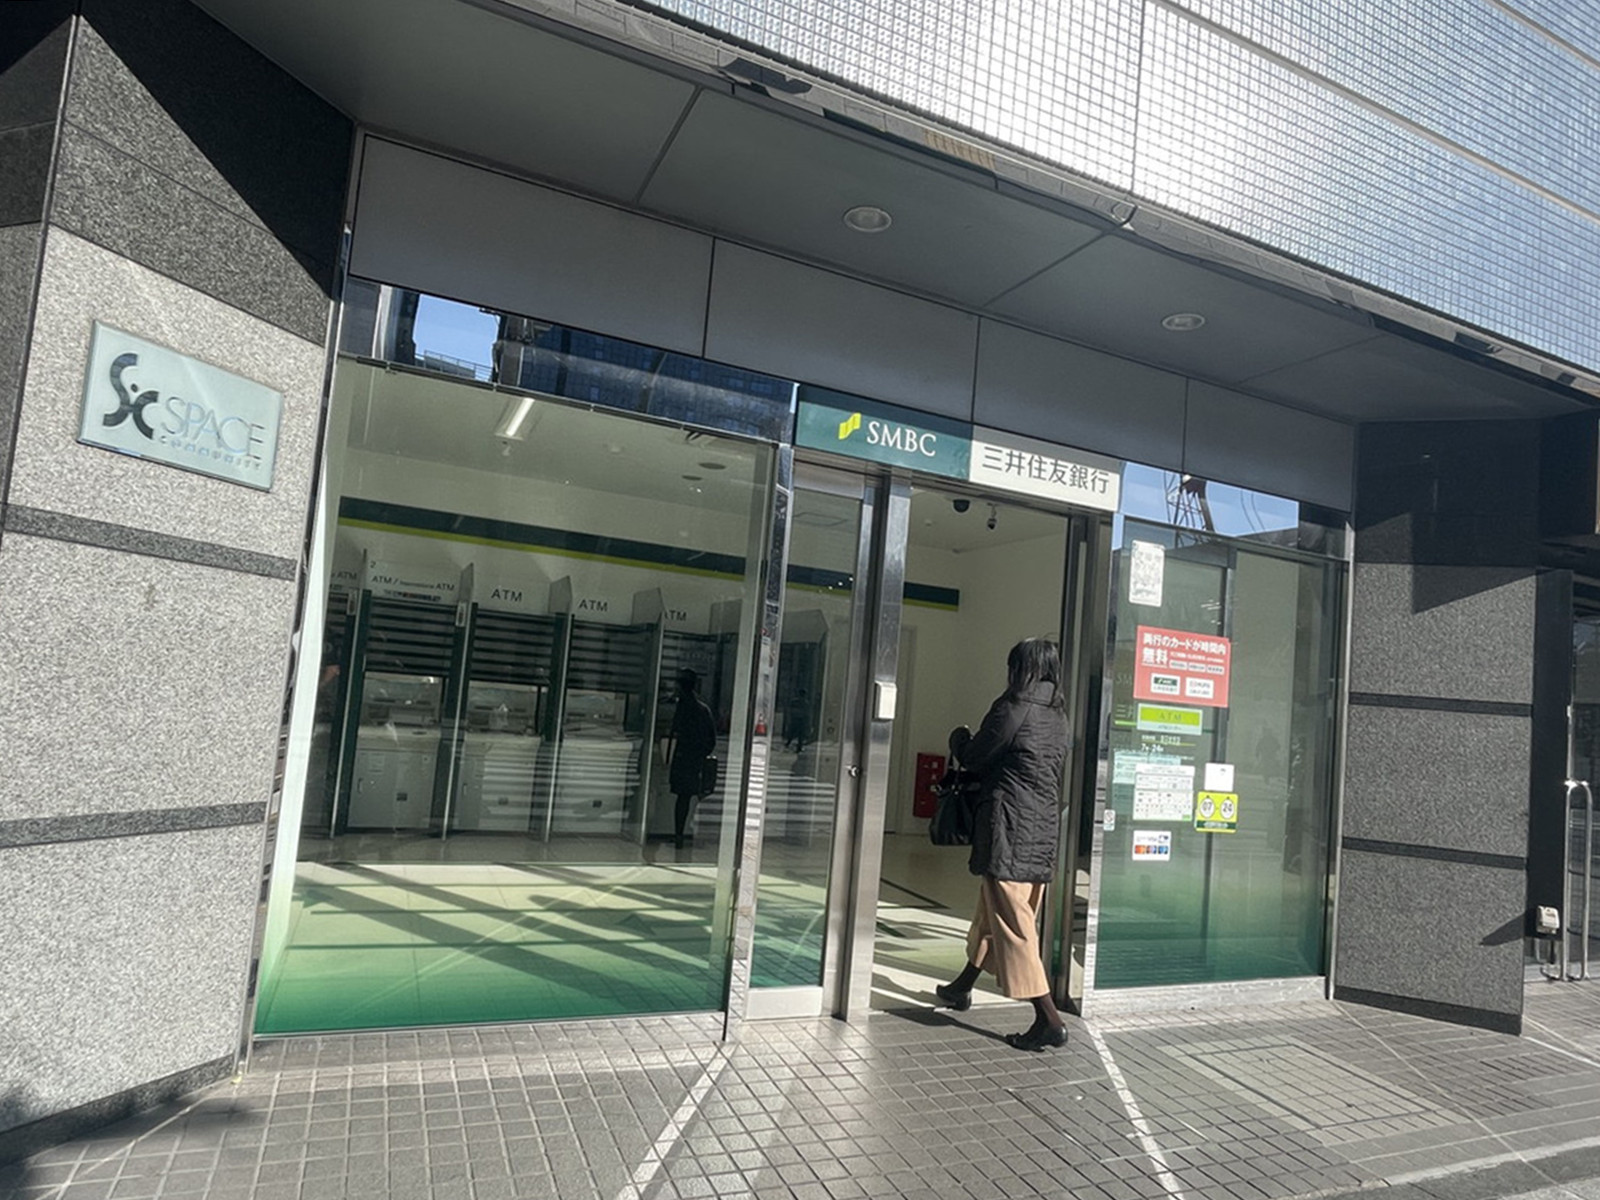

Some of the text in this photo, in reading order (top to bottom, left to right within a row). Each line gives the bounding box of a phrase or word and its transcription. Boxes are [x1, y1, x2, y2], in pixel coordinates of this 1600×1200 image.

[161, 396, 265, 460] SPACE
[866, 421, 937, 457] SMBC
[982, 445, 1110, 495] 三井住友銀行
[372, 575, 393, 585] ATM
[435, 583, 455, 591] ATM
[491, 588, 523, 602] ATM
[578, 599, 608, 612] ATM
